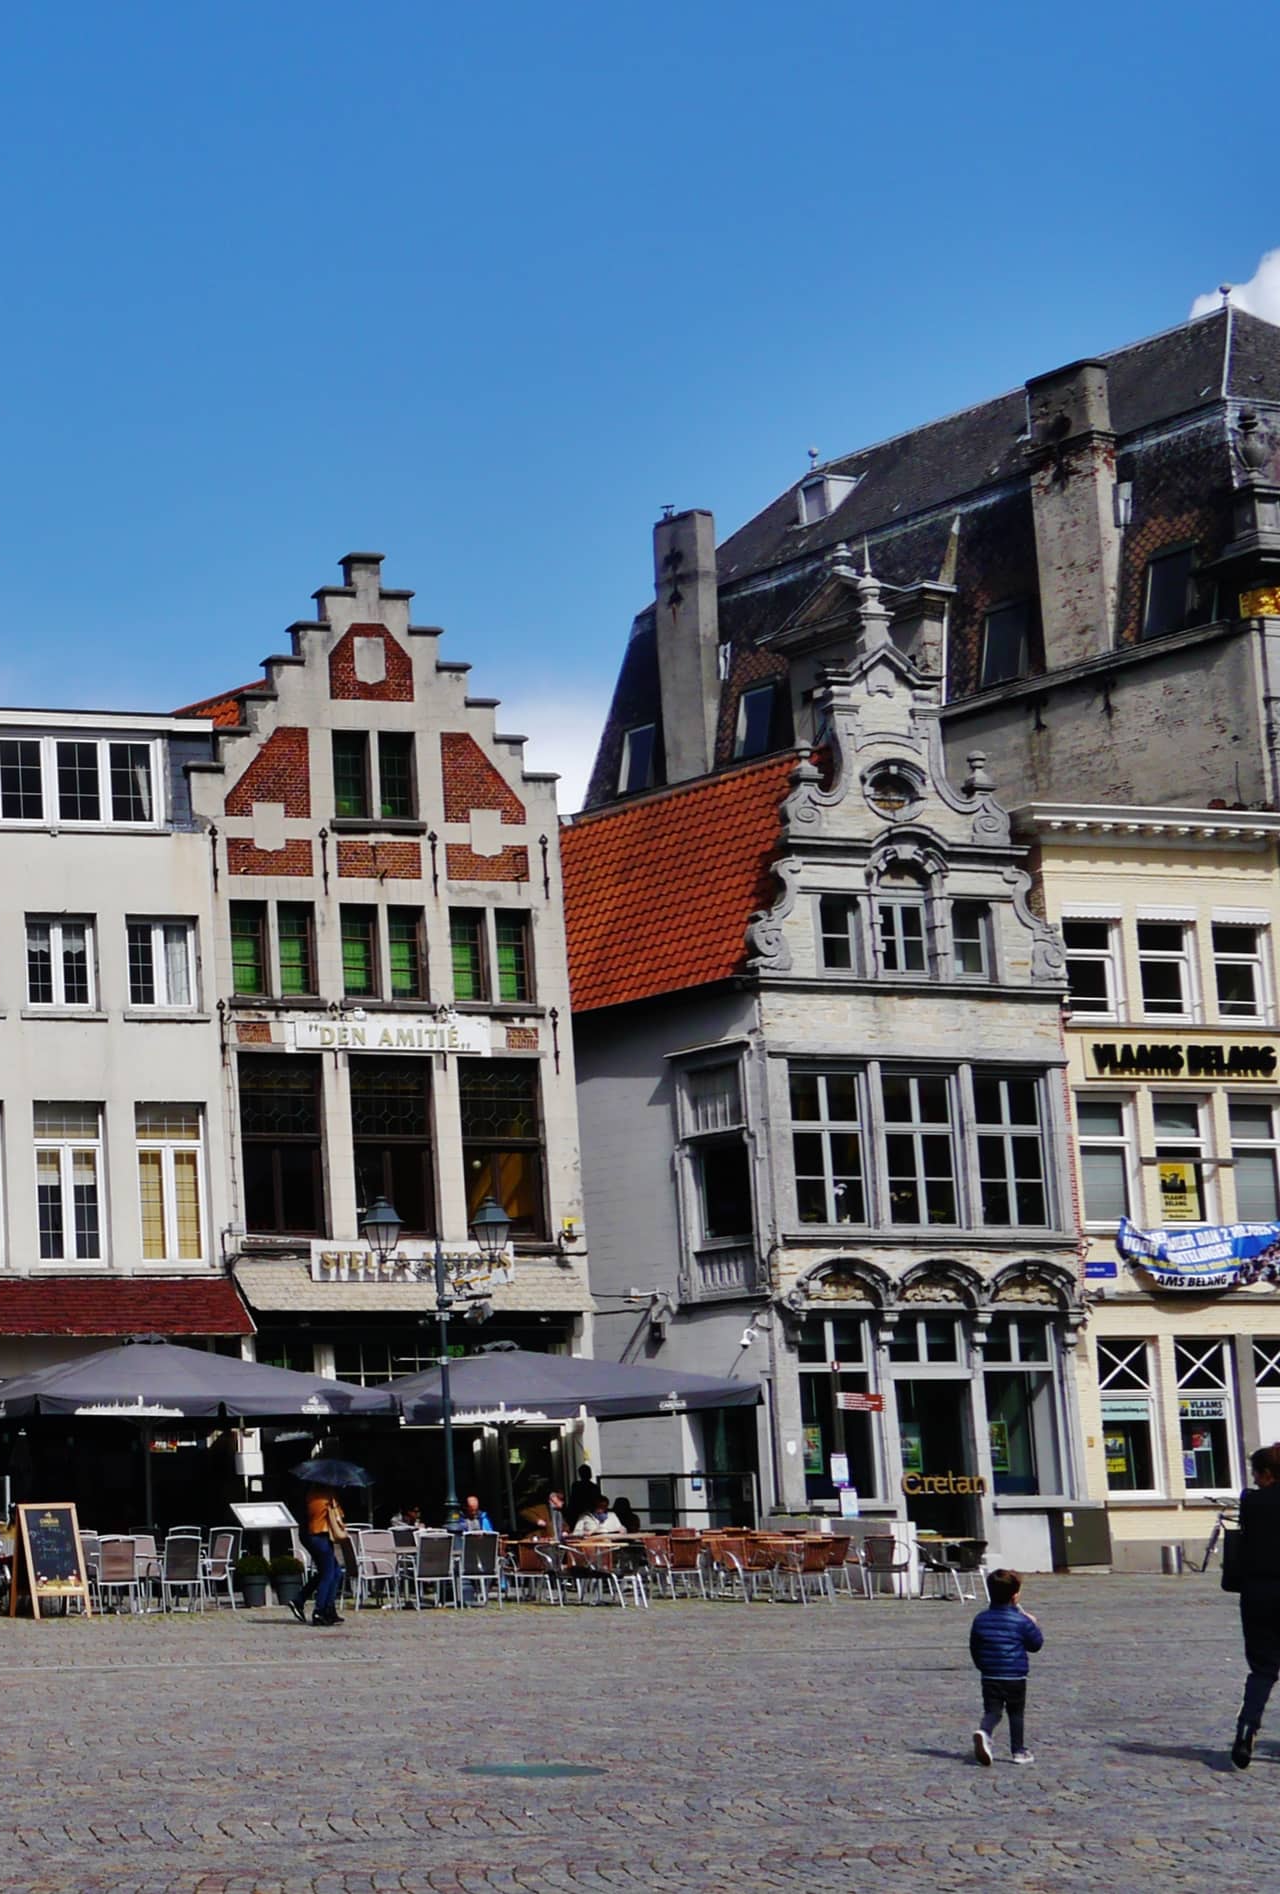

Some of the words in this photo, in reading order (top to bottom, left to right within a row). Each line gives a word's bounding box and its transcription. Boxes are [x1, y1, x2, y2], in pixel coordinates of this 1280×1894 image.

[1092, 1044, 1184, 1076] VLAAMS
[1187, 1045, 1277, 1077] BELANG
[1220, 1229, 1231, 1241] 2
[1157, 1275, 1185, 1287] AMS
[1188, 1274, 1228, 1287] BELANG
[1190, 1401, 1223, 1409] VLAAMS
[1190, 1408, 1224, 1417] BELANG
[901, 1471, 987, 1495] Cretan
